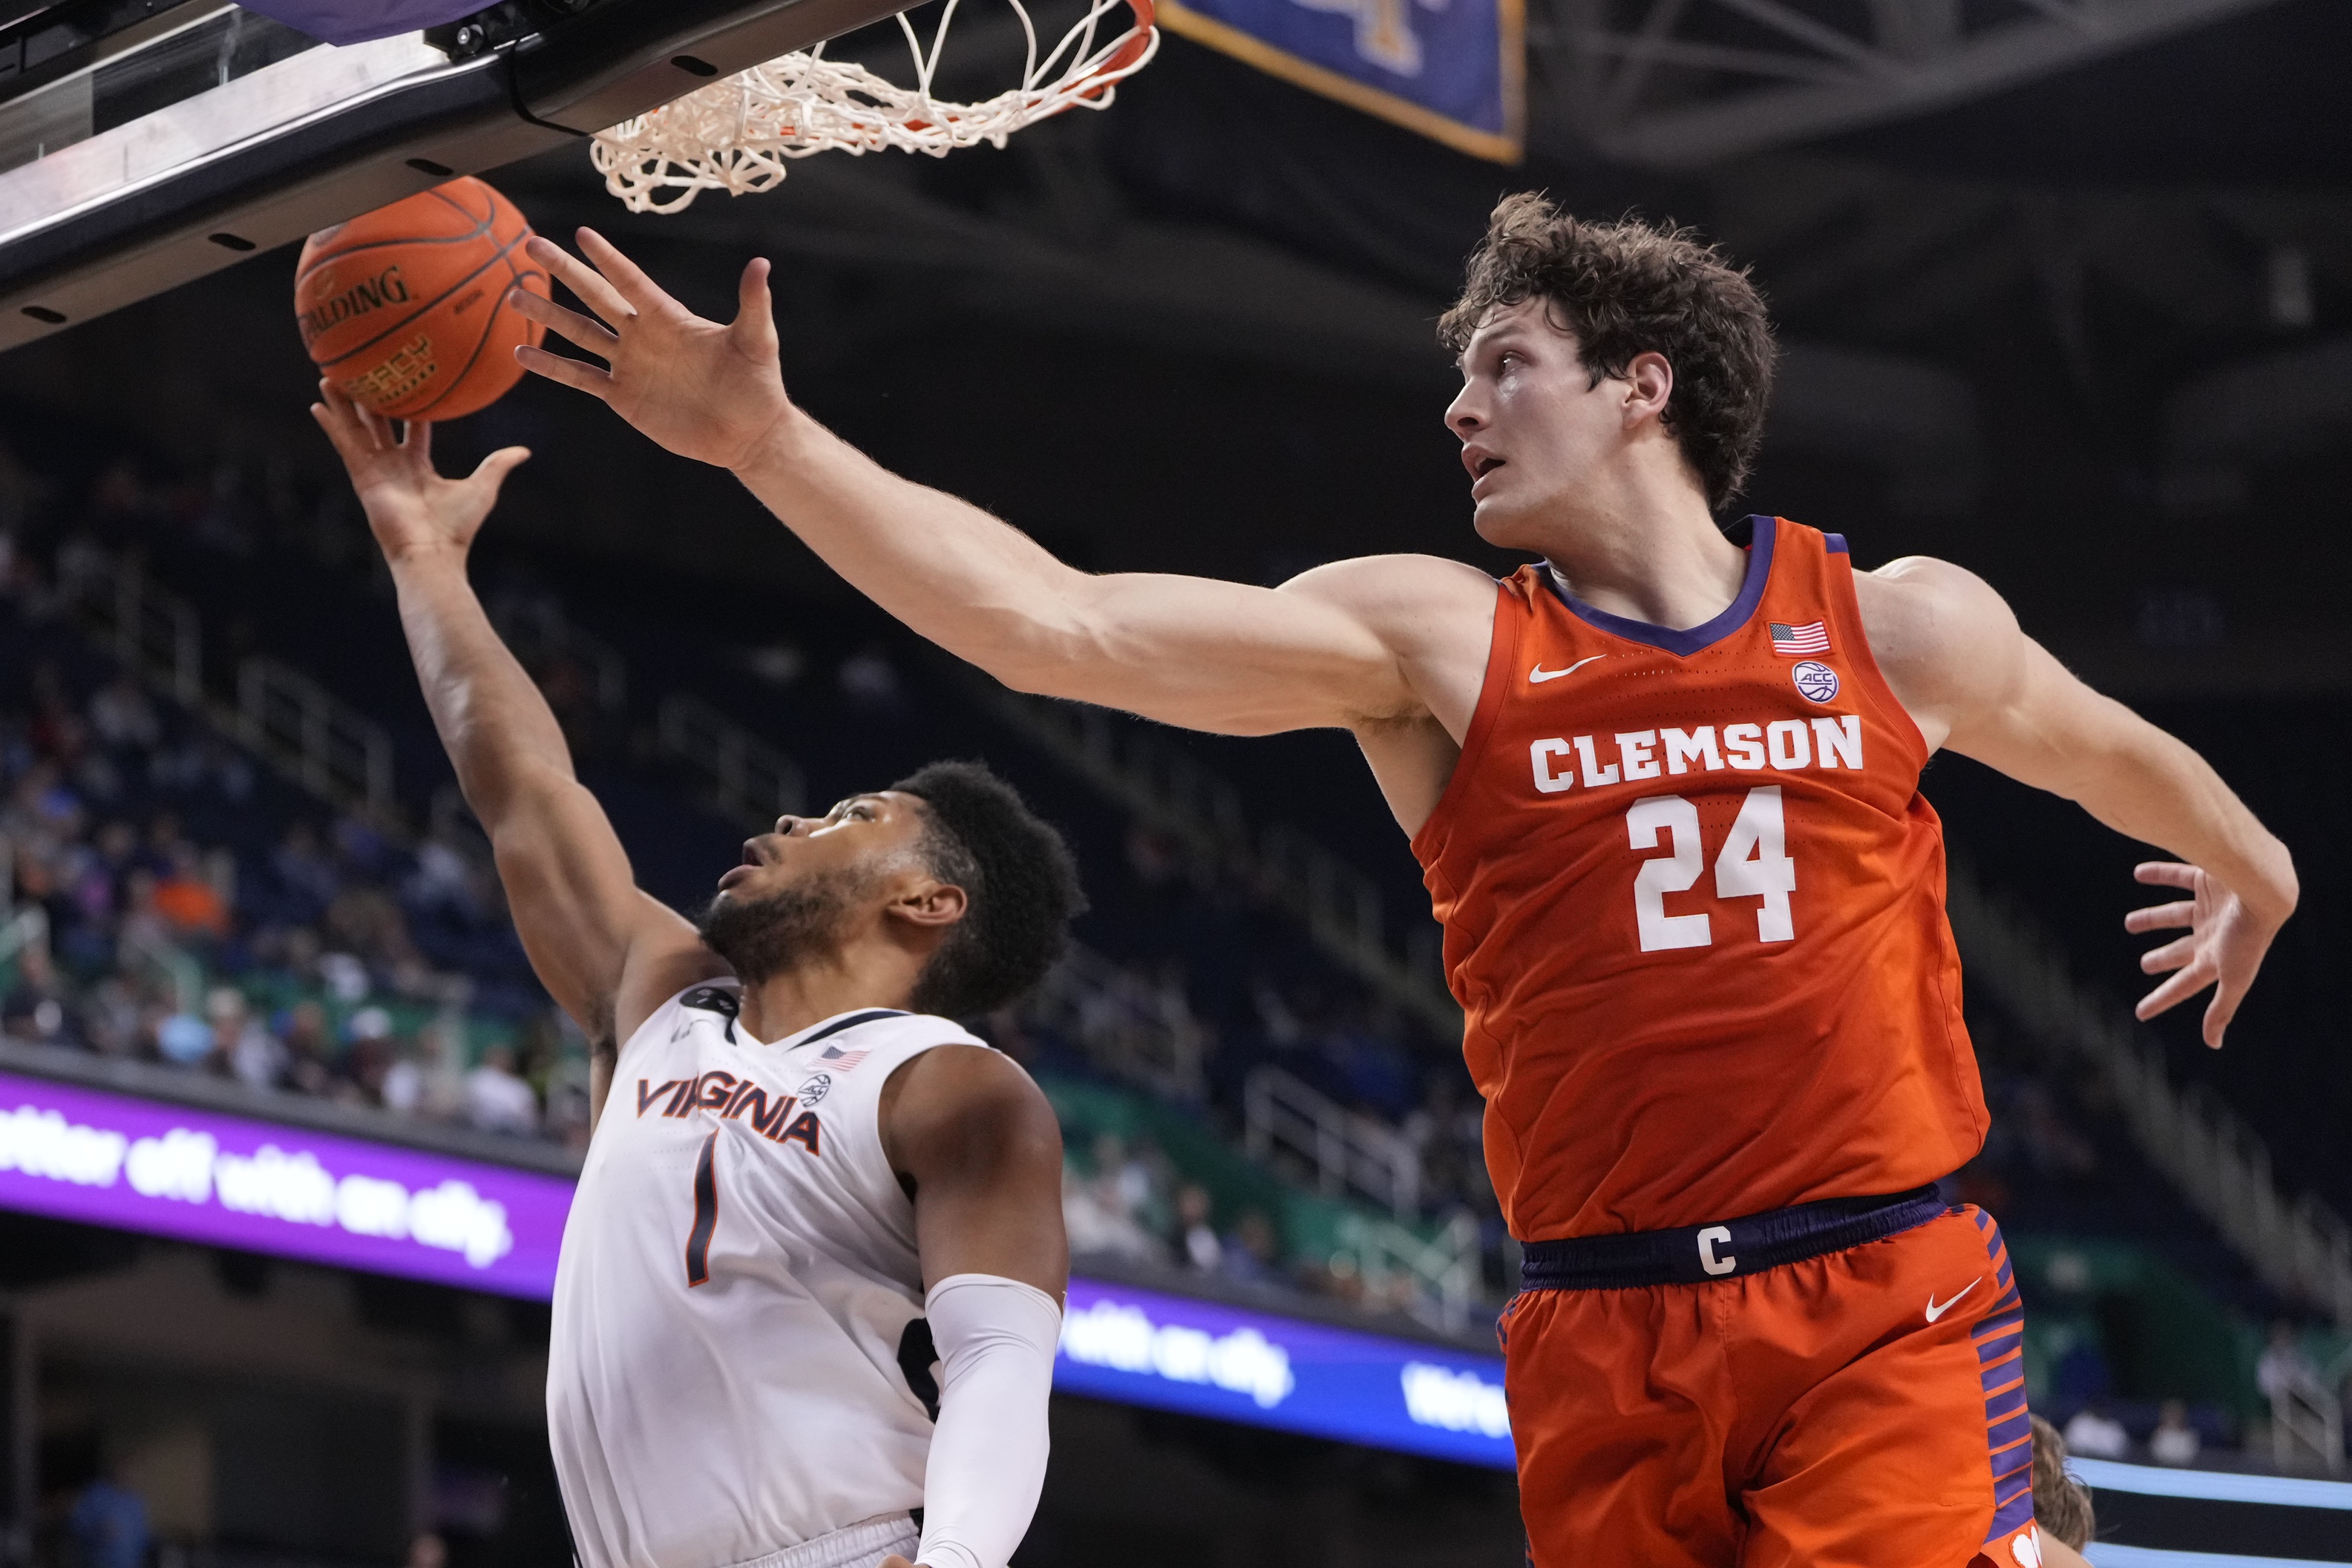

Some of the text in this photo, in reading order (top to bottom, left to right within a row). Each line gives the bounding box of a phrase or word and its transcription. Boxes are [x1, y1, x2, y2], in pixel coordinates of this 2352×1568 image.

[300, 265, 409, 336] ALDING
[1800, 672, 1832, 683] ACC
[1530, 715, 1864, 793] CLEMSON
[1625, 784, 1796, 952] 24
[802, 1084, 829, 1096] ACC
[685, 1126, 720, 1288] 1
[1697, 1225, 1736, 1276] C
